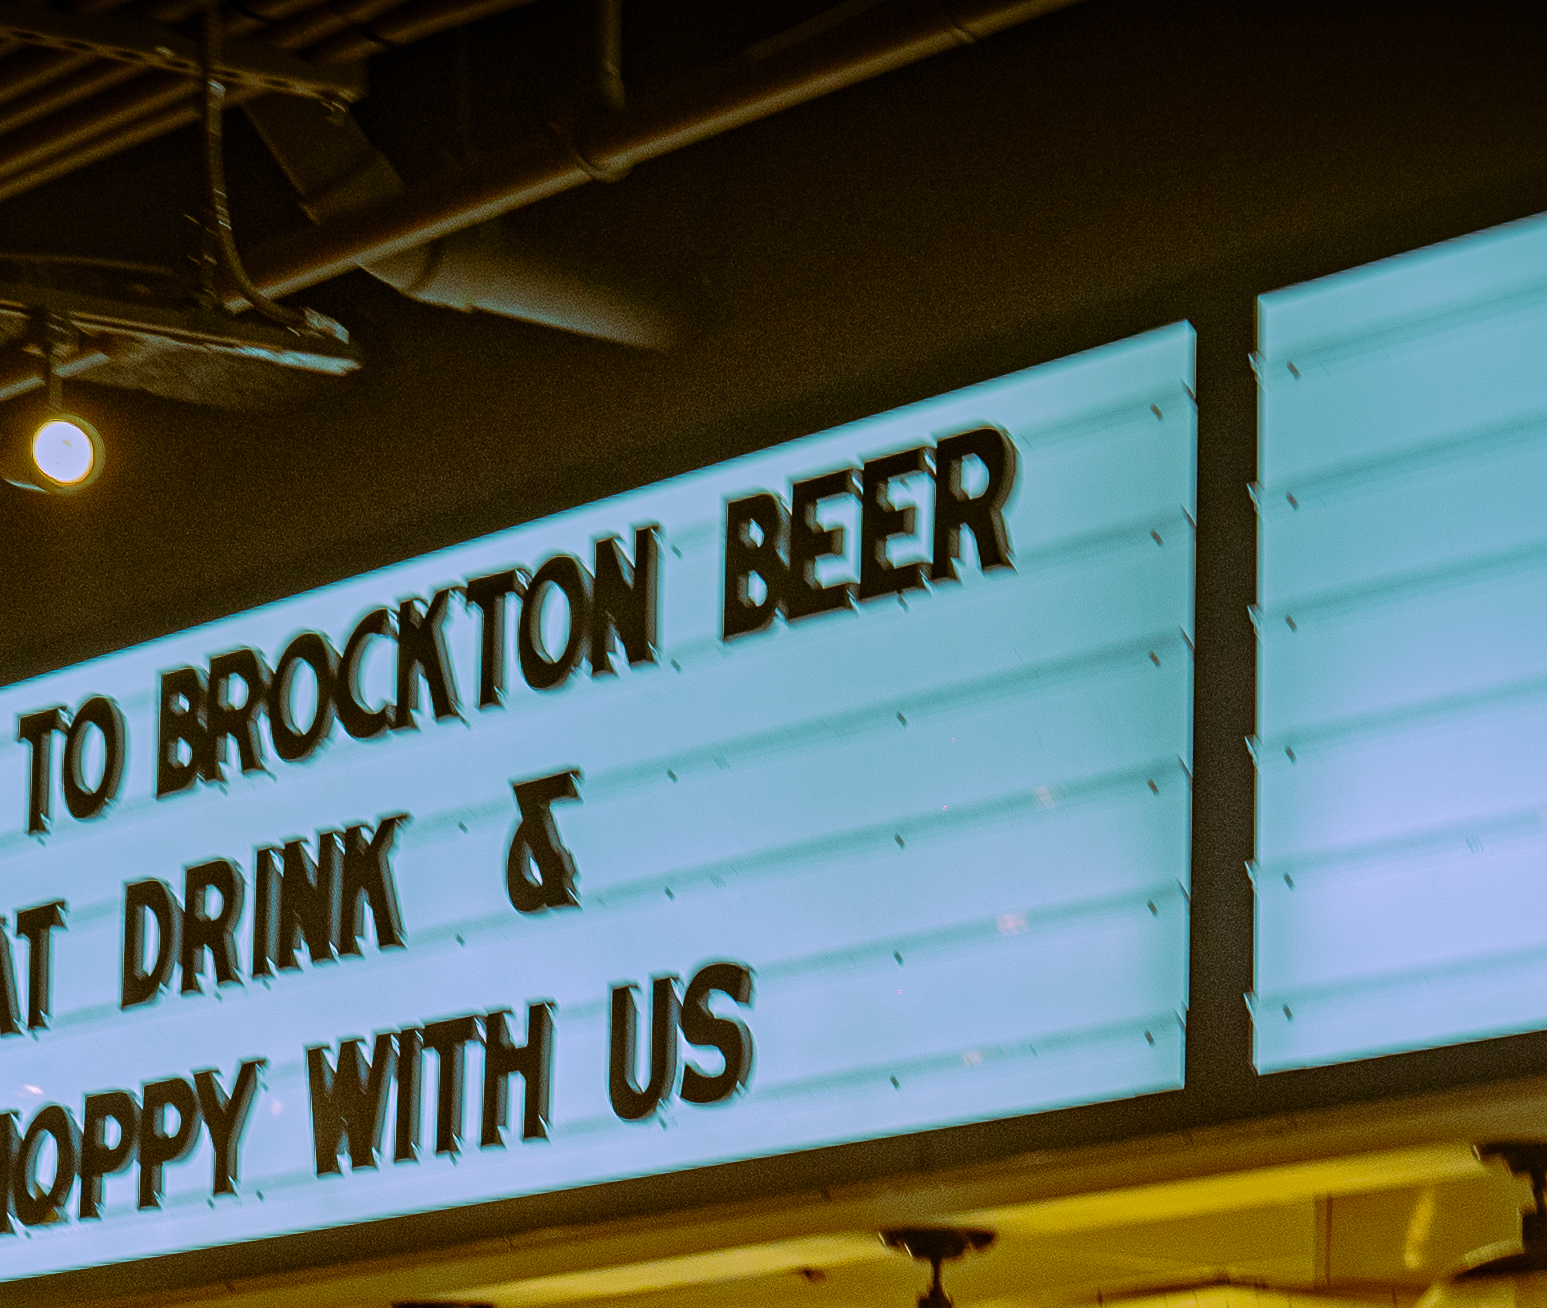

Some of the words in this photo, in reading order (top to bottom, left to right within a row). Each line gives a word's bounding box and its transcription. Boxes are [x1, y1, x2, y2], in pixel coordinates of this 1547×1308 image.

[18, 695, 126, 838] TO
[157, 523, 665, 799] BROCKTON
[722, 425, 1019, 643] BEER
[121, 813, 412, 1009] DRINK
[506, 768, 582, 915] &
[306, 1000, 555, 1178] WITH
[608, 960, 756, 1123] US
